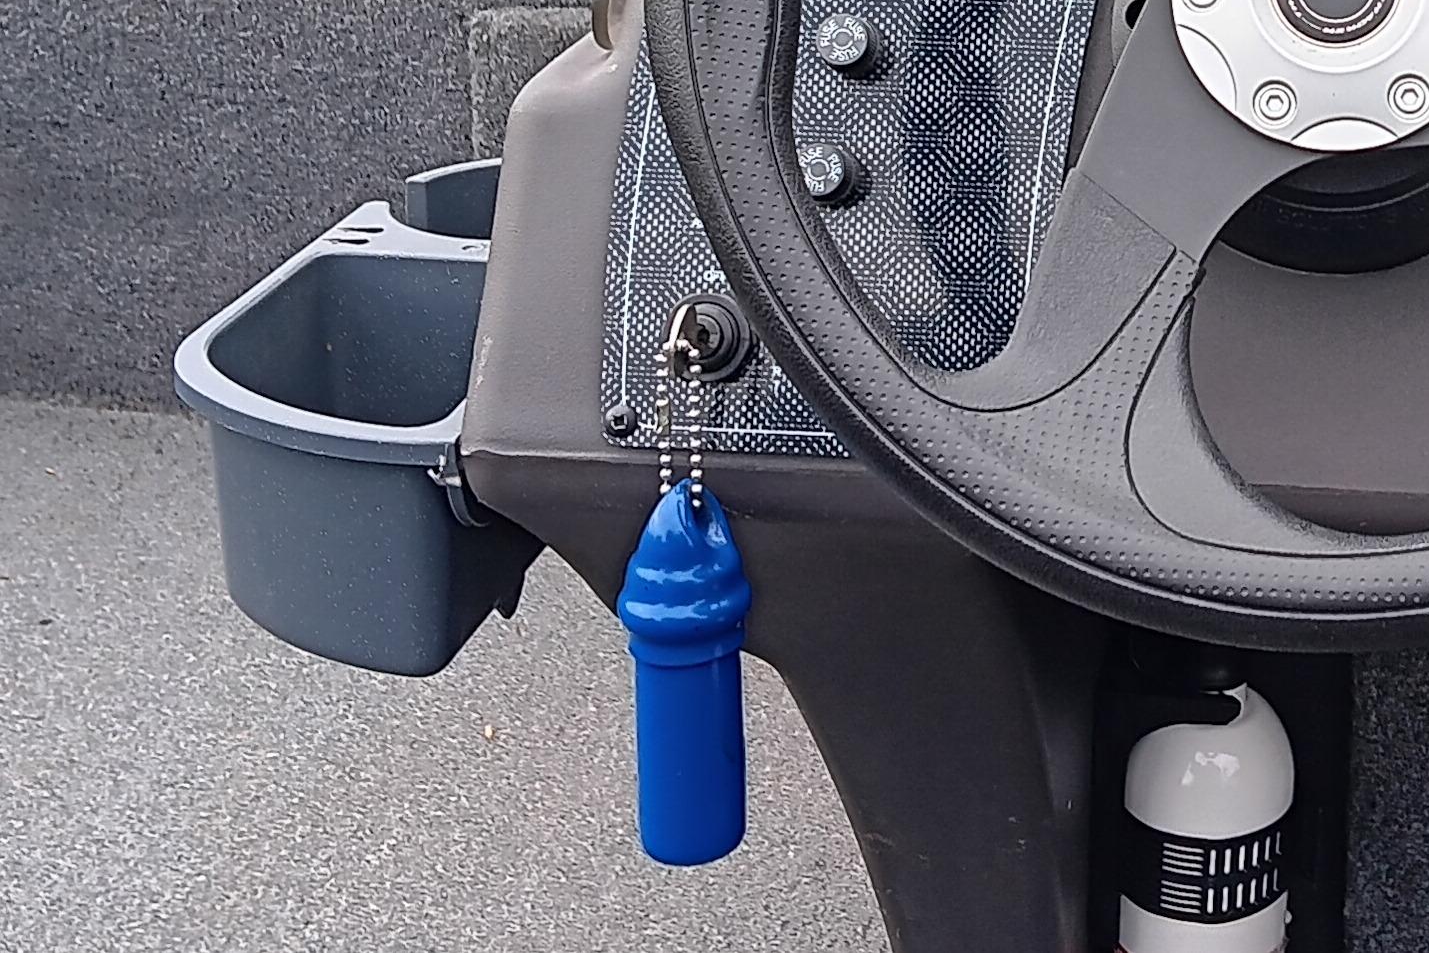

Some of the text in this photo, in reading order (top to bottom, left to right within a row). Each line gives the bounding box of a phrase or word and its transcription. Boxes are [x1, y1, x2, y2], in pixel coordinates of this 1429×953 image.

[820, 19, 839, 47] FUSE
[844, 17, 866, 41] FUSE
[829, 46, 859, 61] FUSE
[799, 146, 824, 168] FUSE
